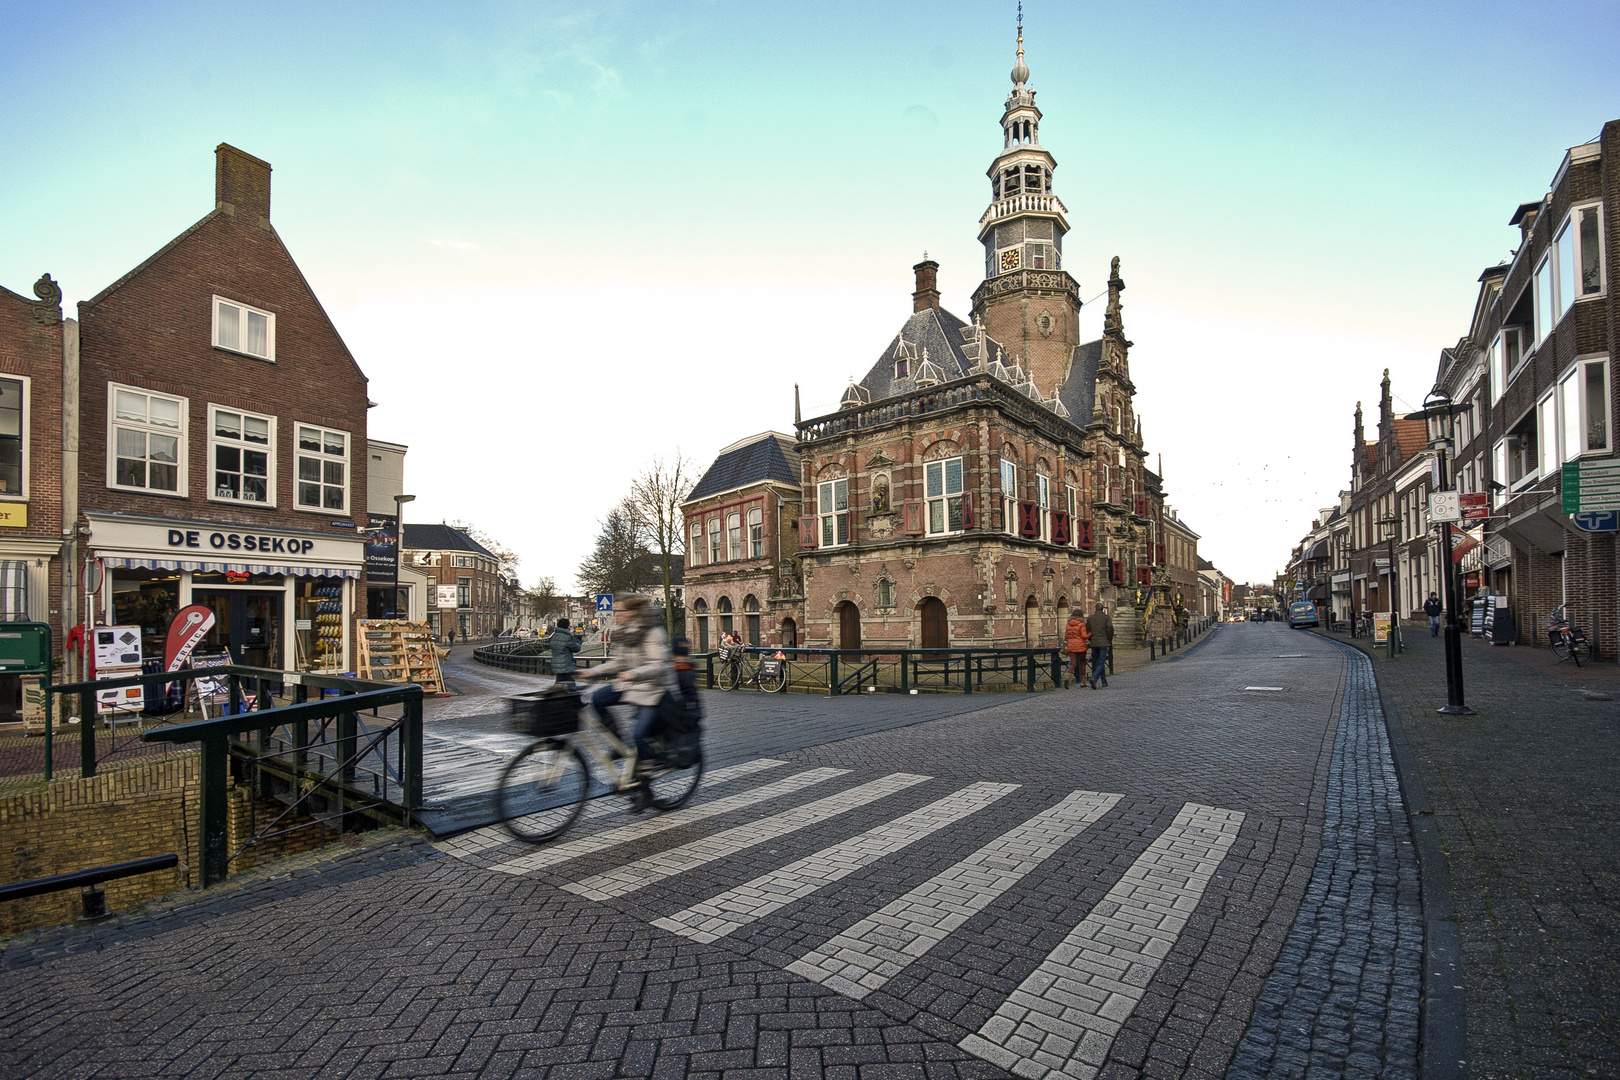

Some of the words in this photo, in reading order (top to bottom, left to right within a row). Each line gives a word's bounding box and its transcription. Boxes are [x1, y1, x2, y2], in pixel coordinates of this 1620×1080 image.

[168, 529, 200, 547] DE
[209, 532, 314, 554] OSSEKOP
[370, 555, 395, 563] Ossekop
[172, 627, 207, 669] SERVICE
